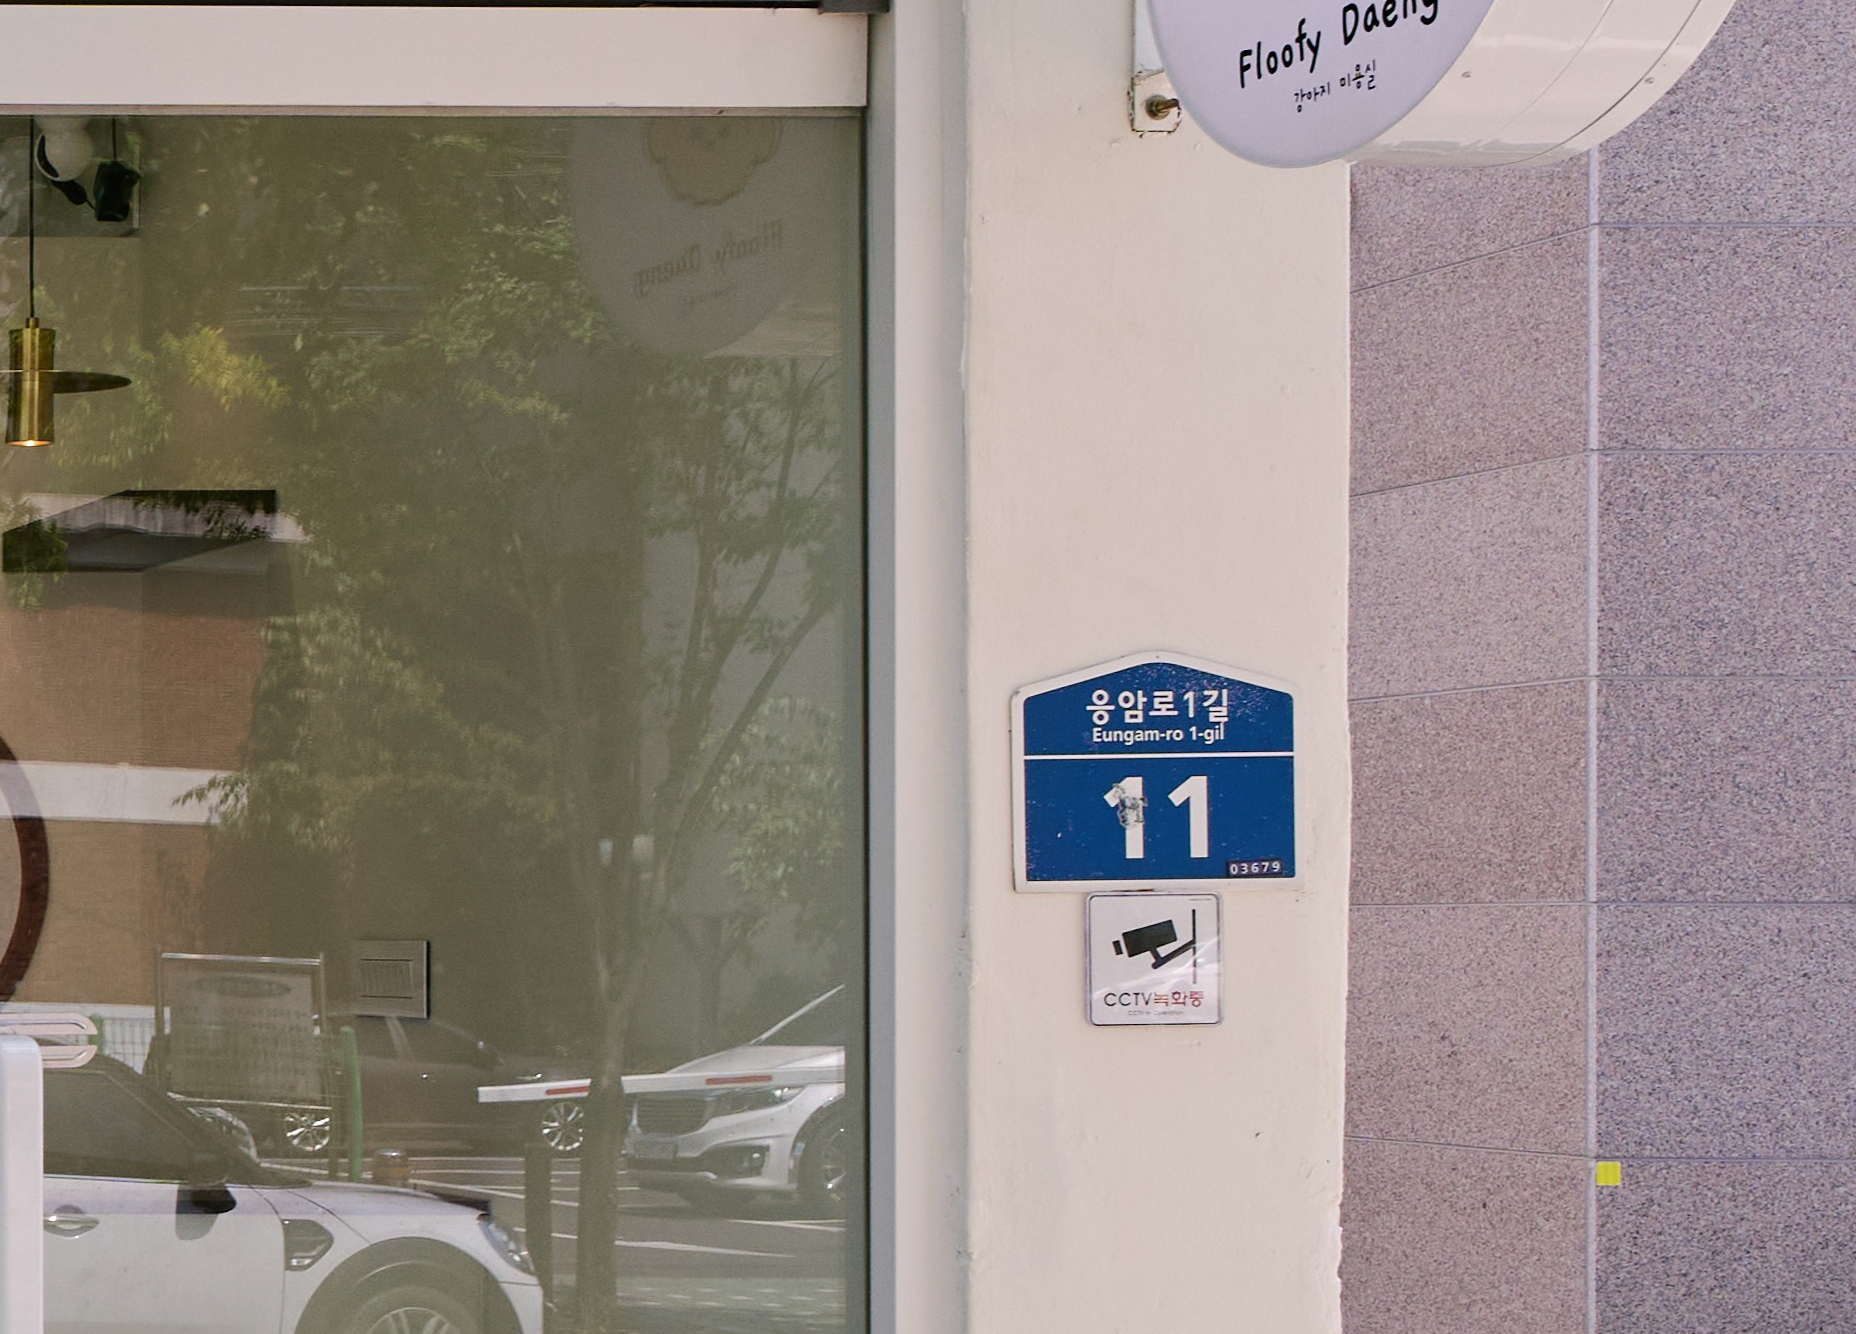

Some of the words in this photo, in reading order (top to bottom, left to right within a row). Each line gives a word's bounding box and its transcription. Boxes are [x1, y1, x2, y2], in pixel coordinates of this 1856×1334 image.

[1239, 17, 1322, 89] Floofy
[1293, 81, 1331, 113] 강아지
[1340, 59, 1377, 90] 미용실
[1085, 688, 1230, 726] 응암로1길
[1092, 727, 1184, 746] Eungam-ro
[1190, 723, 1225, 745] 1-gil
[1102, 775, 1210, 859] 11
[1229, 861, 1282, 876] 03679
